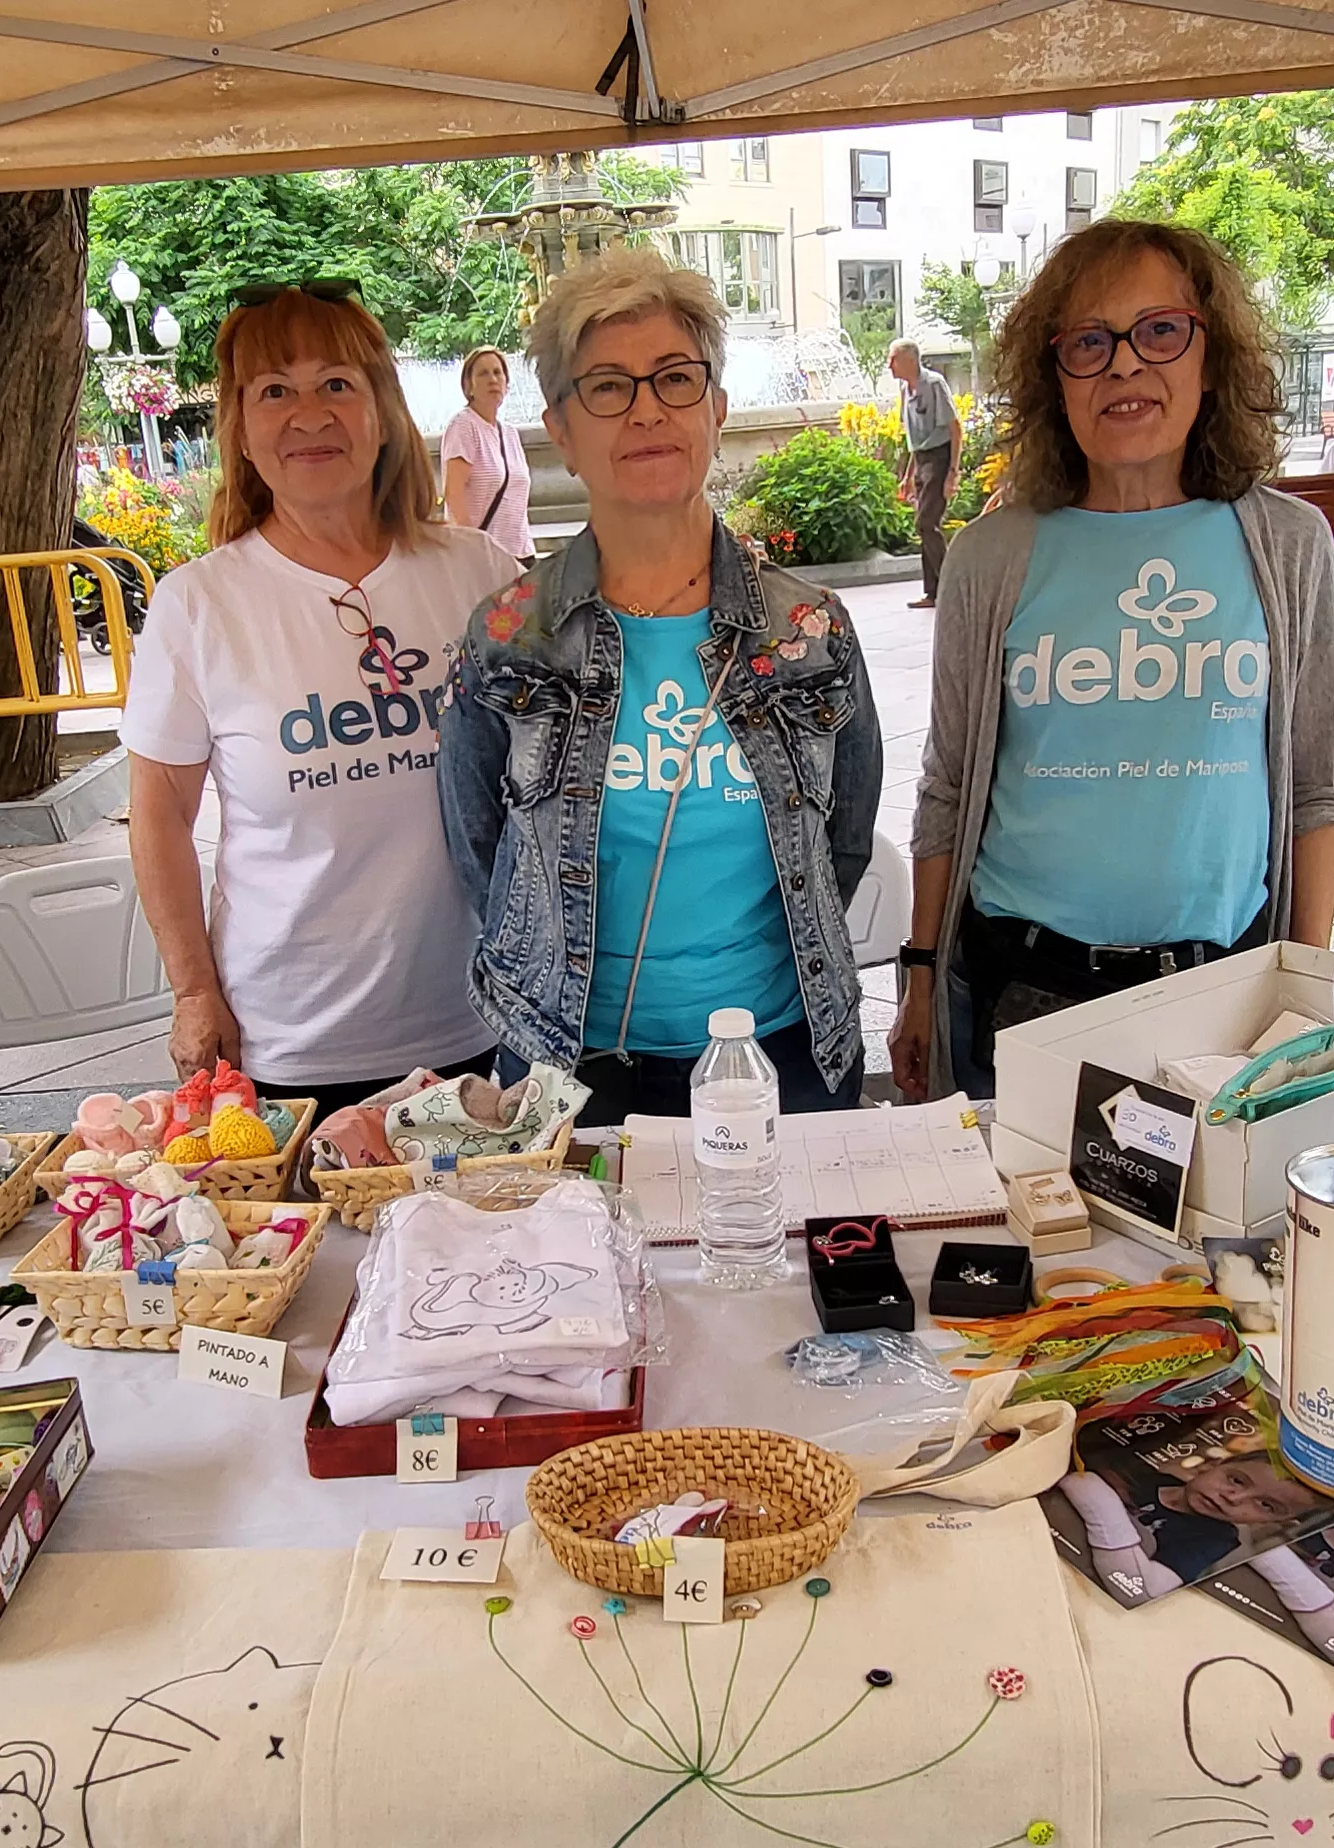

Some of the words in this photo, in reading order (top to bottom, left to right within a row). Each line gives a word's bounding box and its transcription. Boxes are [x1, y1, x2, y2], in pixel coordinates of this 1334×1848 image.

[1008, 628, 1266, 709] debra
[280, 682, 443, 755] debr
[288, 762, 338, 793] Piel
[346, 758, 380, 781] de
[1118, 759, 1151, 779] Piel
[1156, 758, 1180, 777] de
[1186, 757, 1250, 778] Mariposa
[723, 786, 759, 804] Espa
[702, 1137, 748, 1151] PIQUERAS
[1144, 1130, 1177, 1151] debra
[1086, 1142, 1158, 1183] CUARZOS
[141, 1299, 166, 1316] 5€
[197, 1339, 256, 1364] PINTADO
[259, 1356, 269, 1368] A
[208, 1368, 249, 1388] MANO
[412, 1450, 439, 1471] 8€
[411, 1548, 448, 1567] 10
[674, 1579, 708, 1603] 4€
